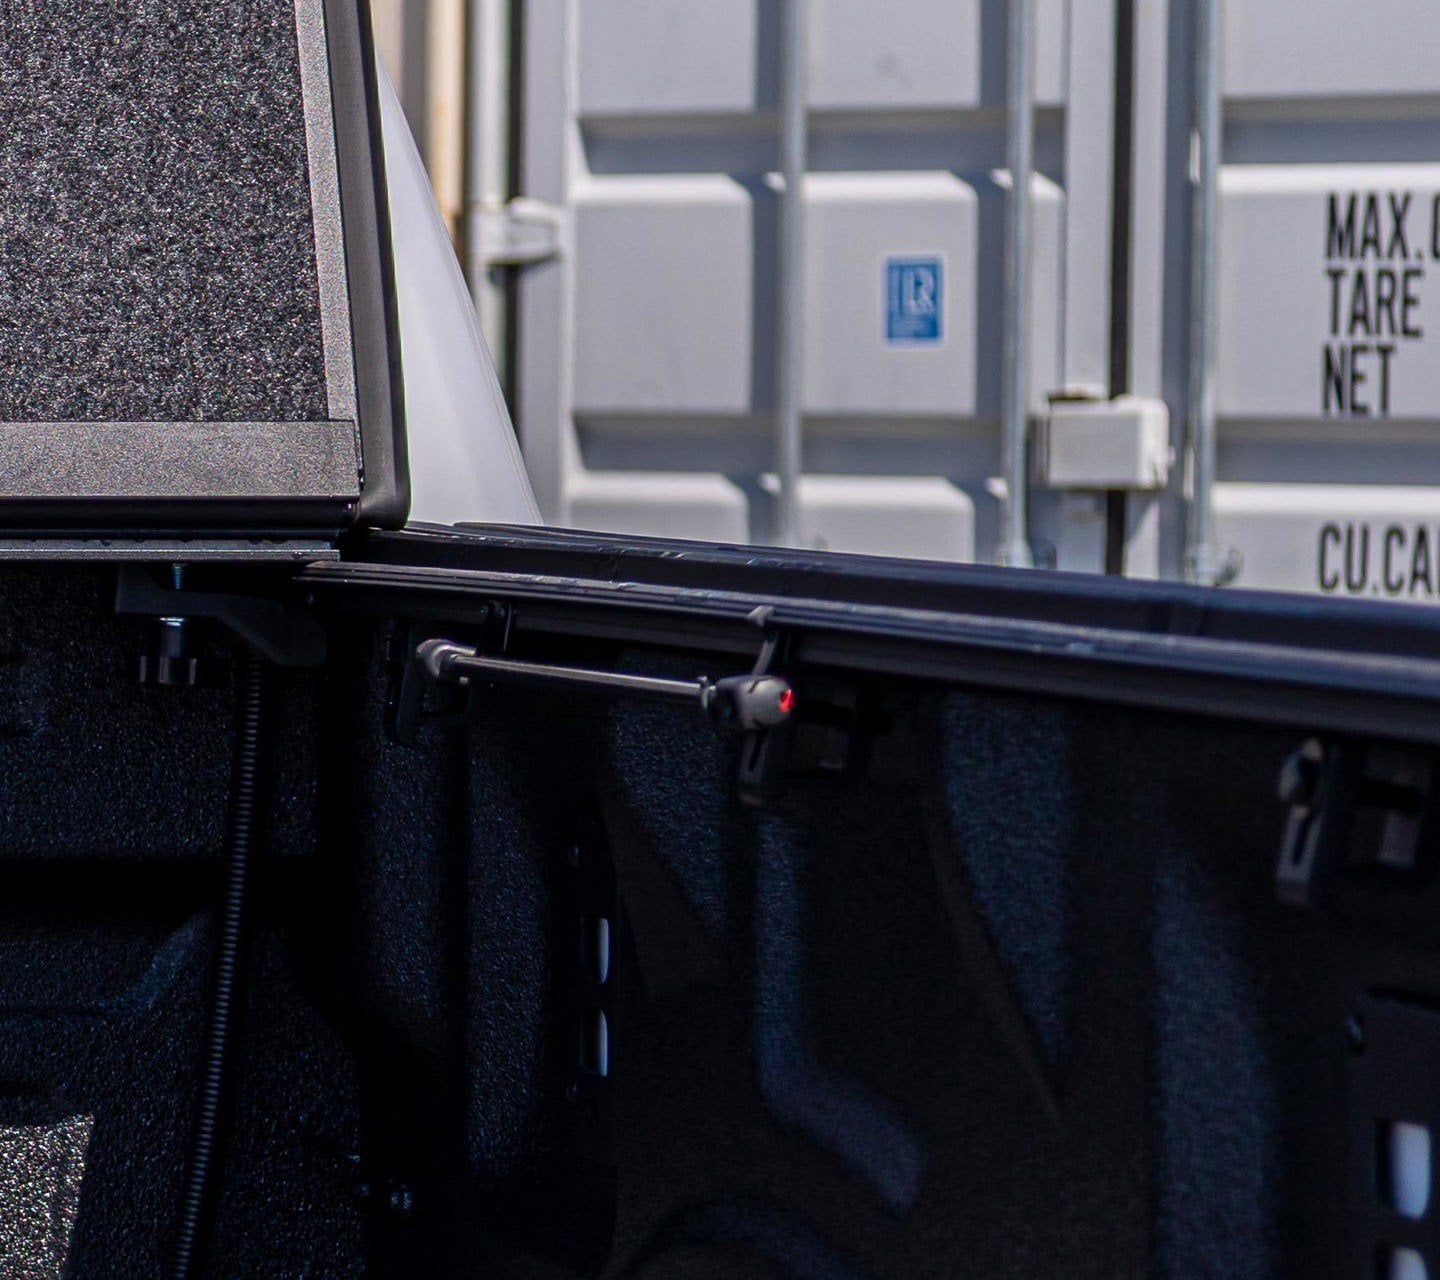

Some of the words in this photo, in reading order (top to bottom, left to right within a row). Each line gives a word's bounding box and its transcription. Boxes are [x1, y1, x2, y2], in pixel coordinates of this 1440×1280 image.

[1324, 190, 1440, 259] MAX.
[1323, 267, 1424, 338] TARE
[1322, 342, 1396, 416] NET
[1318, 522, 1440, 595] CU.CA
